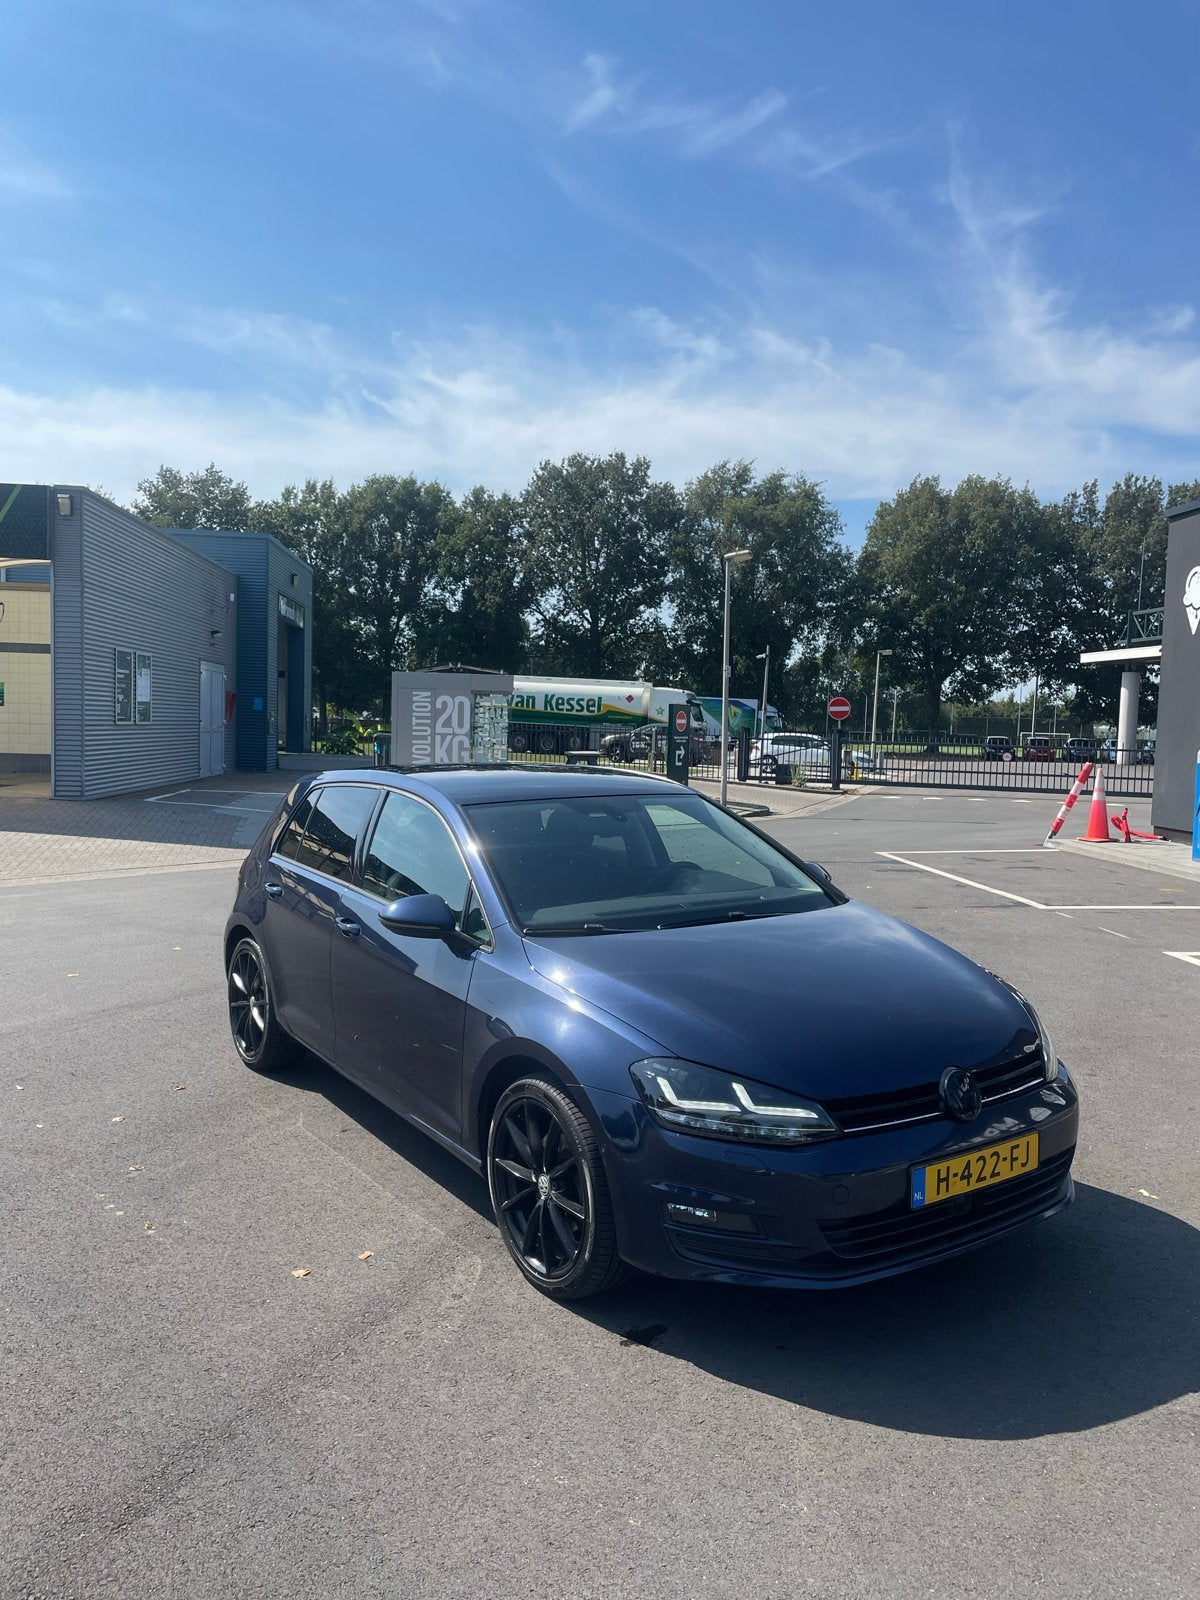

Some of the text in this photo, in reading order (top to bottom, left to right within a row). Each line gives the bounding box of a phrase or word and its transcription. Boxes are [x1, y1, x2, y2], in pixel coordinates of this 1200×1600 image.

[436, 695, 470, 734] 20
[544, 694, 602, 713] Kessel
[435, 735, 470, 764] KG
[936, 1141, 1030, 1195] H-422-FJ
[914, 1191, 924, 1201] NL
